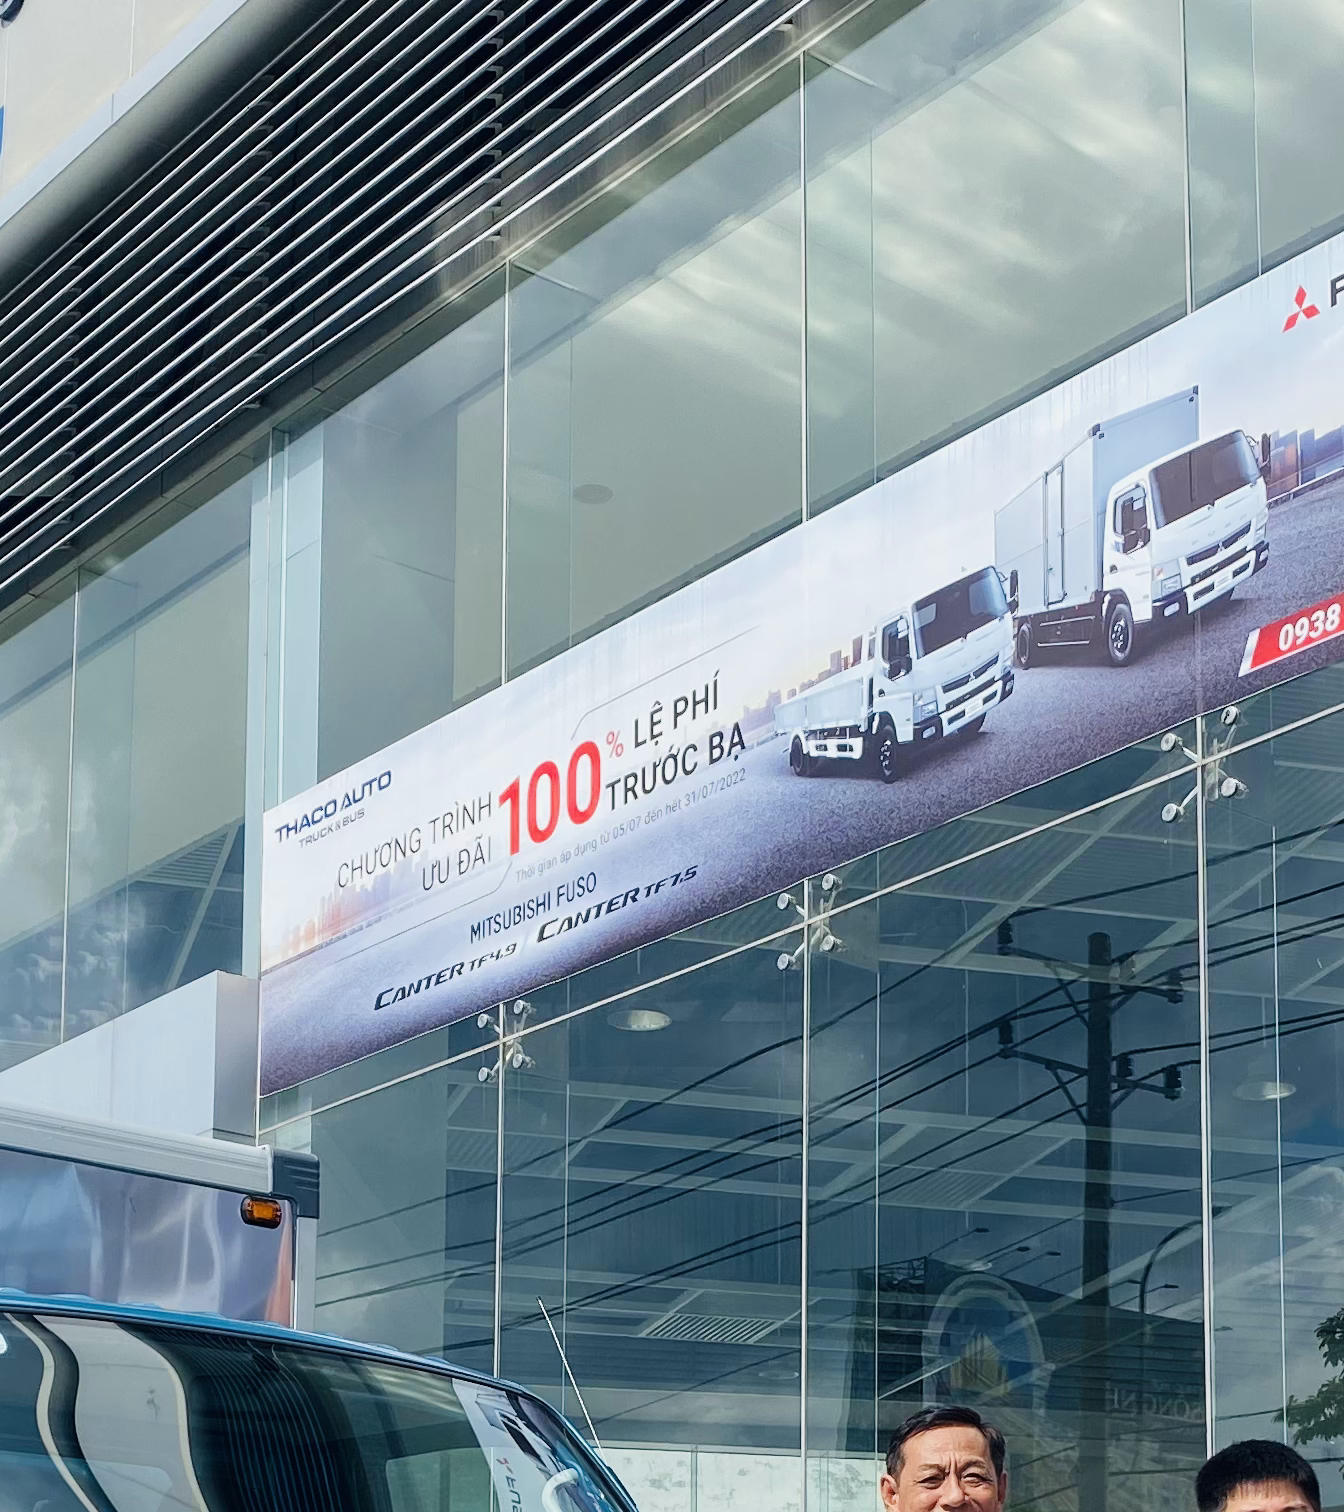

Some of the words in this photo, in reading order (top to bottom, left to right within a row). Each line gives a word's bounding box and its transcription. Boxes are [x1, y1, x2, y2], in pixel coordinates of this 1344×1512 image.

[1278, 602, 1341, 652] 0938
[634, 700, 663, 748] LỆ
[673, 668, 720, 729] PHÍ
[605, 743, 698, 811] TRƯỚC
[708, 721, 746, 766] BẠ
[275, 799, 337, 842] THACO
[340, 770, 392, 810] AUTO
[613, 815, 641, 839] 05/07
[685, 767, 746, 806] 31/07/2022
[338, 828, 421, 888] CHƯƠNG
[429, 792, 492, 844] TRÌNH
[422, 856, 450, 891] ƯU
[457, 834, 491, 876] ĐÃI
[470, 890, 551, 944] MITSUBISHI
[557, 871, 597, 907] FUSO
[536, 887, 639, 944] CANTER
[373, 961, 465, 1011] CANTER
